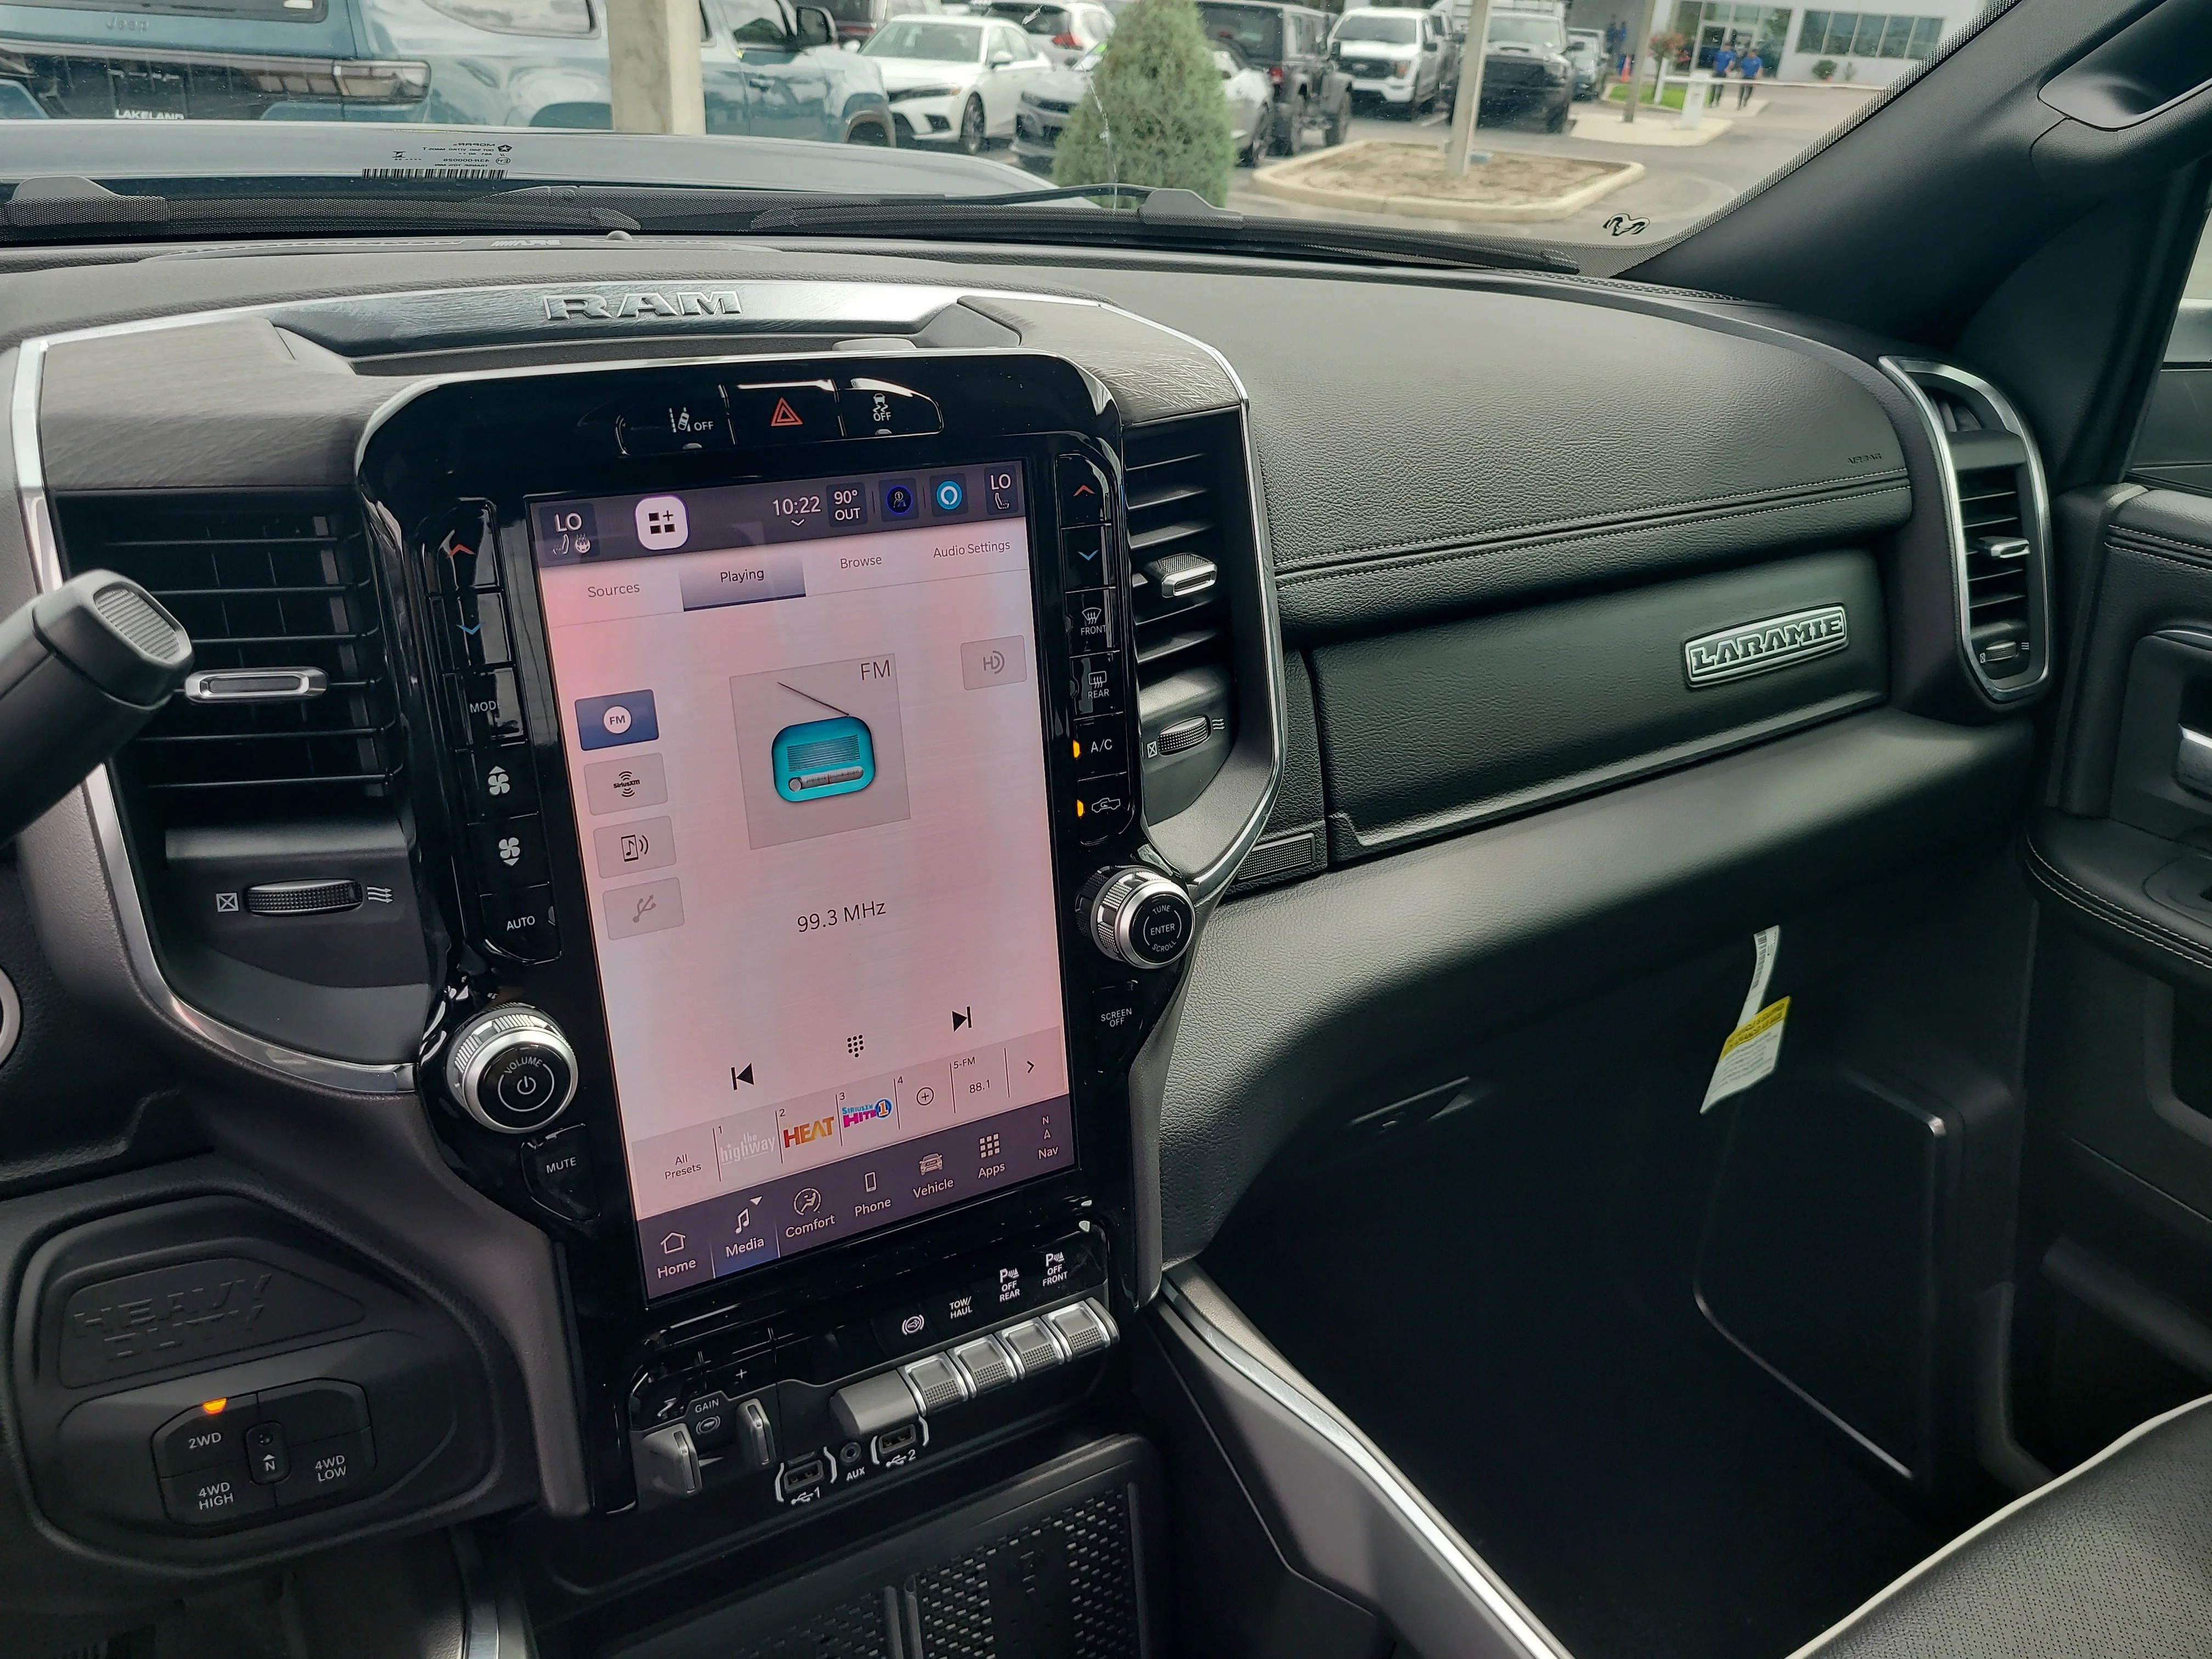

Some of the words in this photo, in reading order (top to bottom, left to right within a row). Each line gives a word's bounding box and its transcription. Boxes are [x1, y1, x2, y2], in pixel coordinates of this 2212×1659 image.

[114, 109, 185, 120] LAKELAND
[543, 290, 743, 321] RAM
[873, 411, 891, 422] OFF
[693, 420, 714, 432] OFF
[990, 473, 1011, 492] LO
[833, 488, 859, 506] 90°
[771, 494, 822, 517] 10:22
[834, 506, 861, 522] OUT
[554, 512, 583, 533] LO
[933, 543, 965, 559] Audio
[967, 538, 1011, 557] Settings
[839, 554, 883, 569] Browse
[720, 567, 765, 585] Playing
[587, 581, 641, 599] Sources
[1080, 624, 1107, 636] FRONT
[1691, 614, 1843, 672] LARAMIE
[860, 659, 892, 681] FM
[1088, 689, 1110, 699] REAR
[609, 714, 626, 726] FM
[1090, 737, 1114, 752] A/C
[796, 908, 838, 934] 99.3
[843, 901, 887, 923] MHz
[1152, 904, 1171, 915] TUNE
[506, 916, 536, 931] AUTO
[1150, 923, 1176, 936] ENTER
[1152, 940, 1177, 952] SCROLL
[1101, 1007, 1132, 1022] SCREEN
[1109, 1017, 1125, 1028] OFF
[504, 1056, 543, 1075] VOLUME
[953, 1056, 976, 1069] 5-FM
[897, 1076, 904, 1084] 4
[969, 1079, 990, 1093] 88.1
[839, 1092, 845, 1101] 3
[779, 1108, 786, 1117] 2
[718, 1125, 723, 1134] 1
[783, 1116, 834, 1148] HEAT
[743, 1132, 758, 1144] the
[720, 1136, 776, 1163] highway
[1039, 1146, 1059, 1160] Nav
[546, 1156, 577, 1173] MUTE
[675, 1153, 688, 1165] All
[665, 1163, 702, 1180] Presets
[978, 1161, 1006, 1181] Apps
[913, 1176, 954, 1199] Vehicle
[854, 1197, 892, 1217] Phone
[785, 1214, 835, 1239] Comfort
[725, 1236, 765, 1259] Media
[657, 1257, 697, 1279] Home
[1047, 1263, 1063, 1276] OFF
[1001, 1280, 1017, 1293] OFF
[1042, 1271, 1068, 1287] FRONT
[949, 1296, 972, 1311] TOW/
[999, 1289, 1020, 1302] REAR
[950, 1305, 973, 1319] HAUL
[695, 1397, 720, 1415] GAIN
[188, 1431, 222, 1449] 2WD
[314, 1454, 346, 1471] 4WD
[908, 1449, 916, 1462] 2
[266, 1460, 275, 1471] N
[317, 1465, 347, 1482] LOW
[845, 1466, 866, 1482] AUX
[198, 1481, 231, 1498] 4WD
[198, 1493, 234, 1510] HIGH
